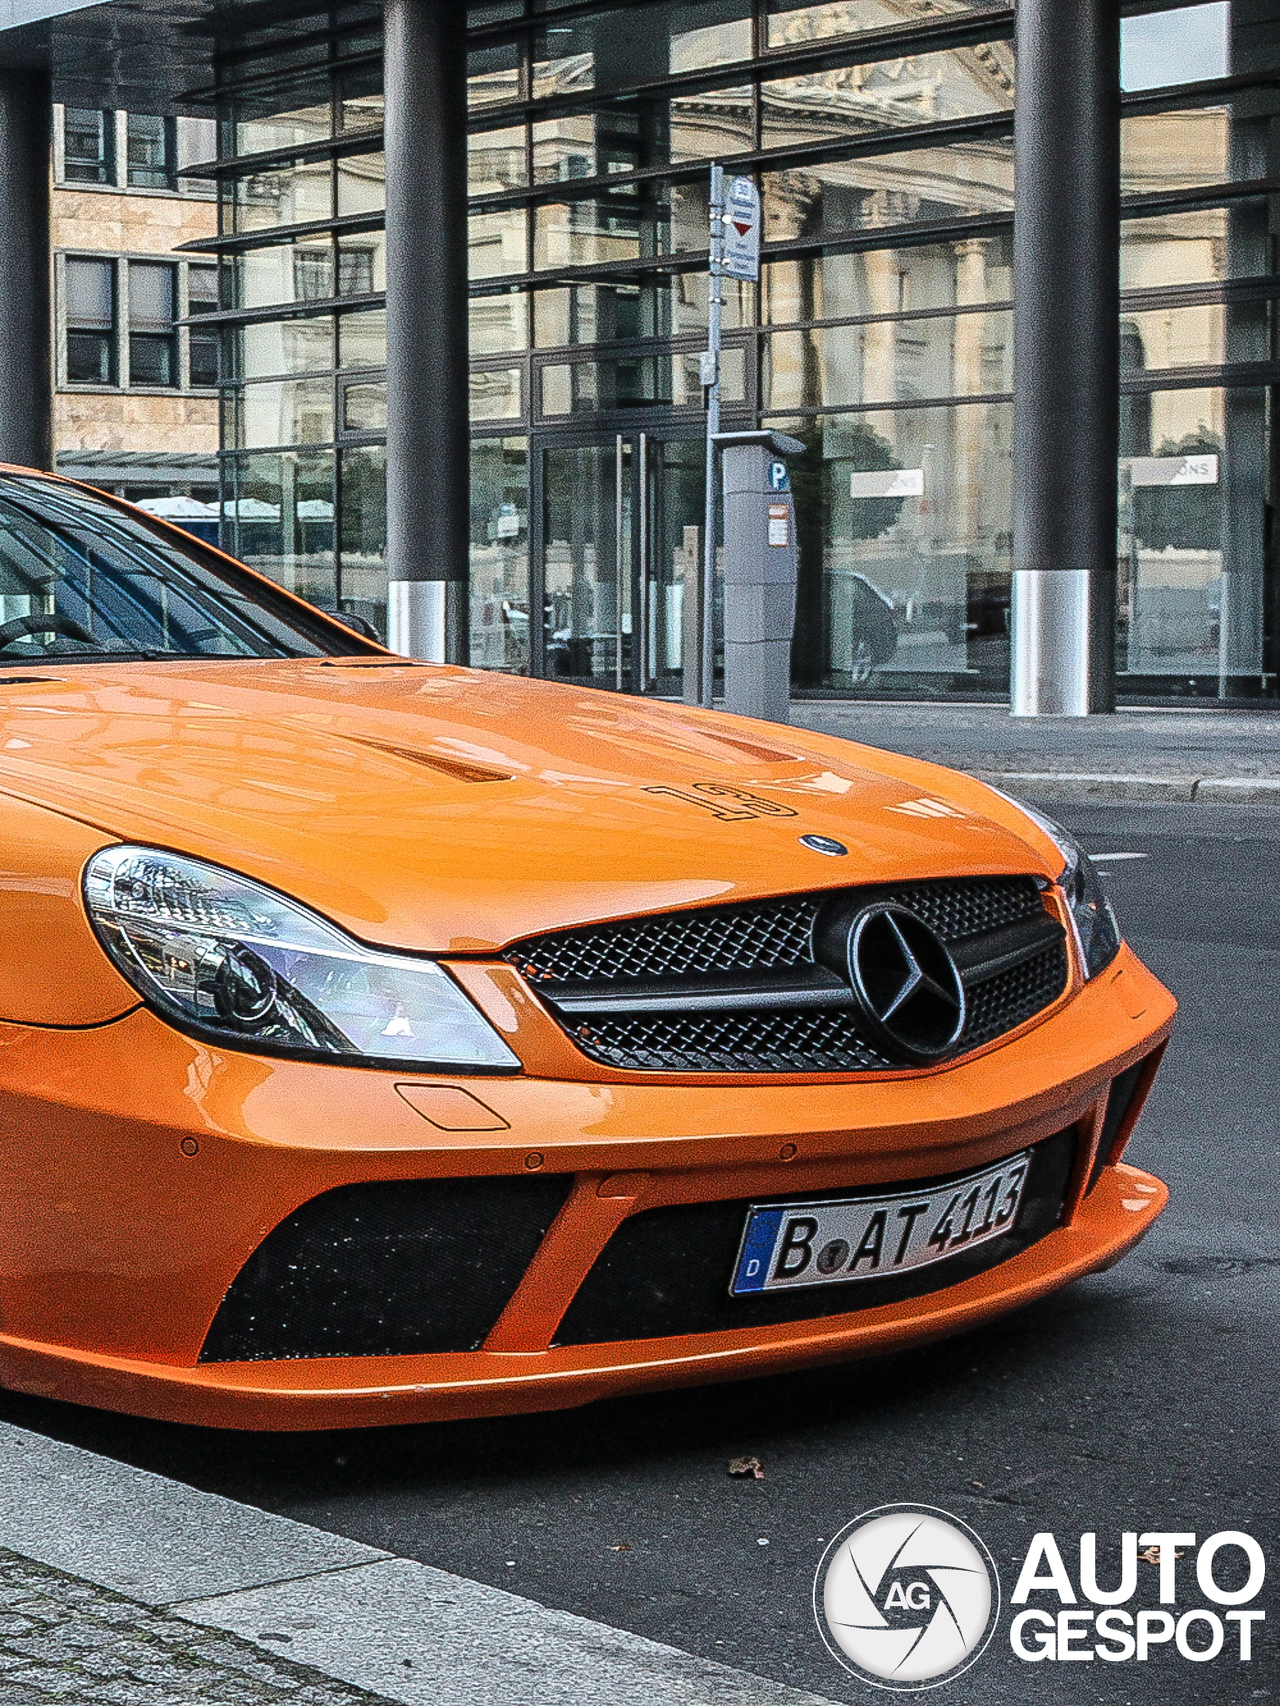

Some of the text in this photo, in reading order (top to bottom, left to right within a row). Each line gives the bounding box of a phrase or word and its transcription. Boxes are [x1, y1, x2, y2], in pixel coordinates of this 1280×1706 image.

[772, 463, 787, 489] P
[640, 783, 799, 822] 13
[772, 1160, 1029, 1280] B AT 4113
[746, 1258, 760, 1277] D
